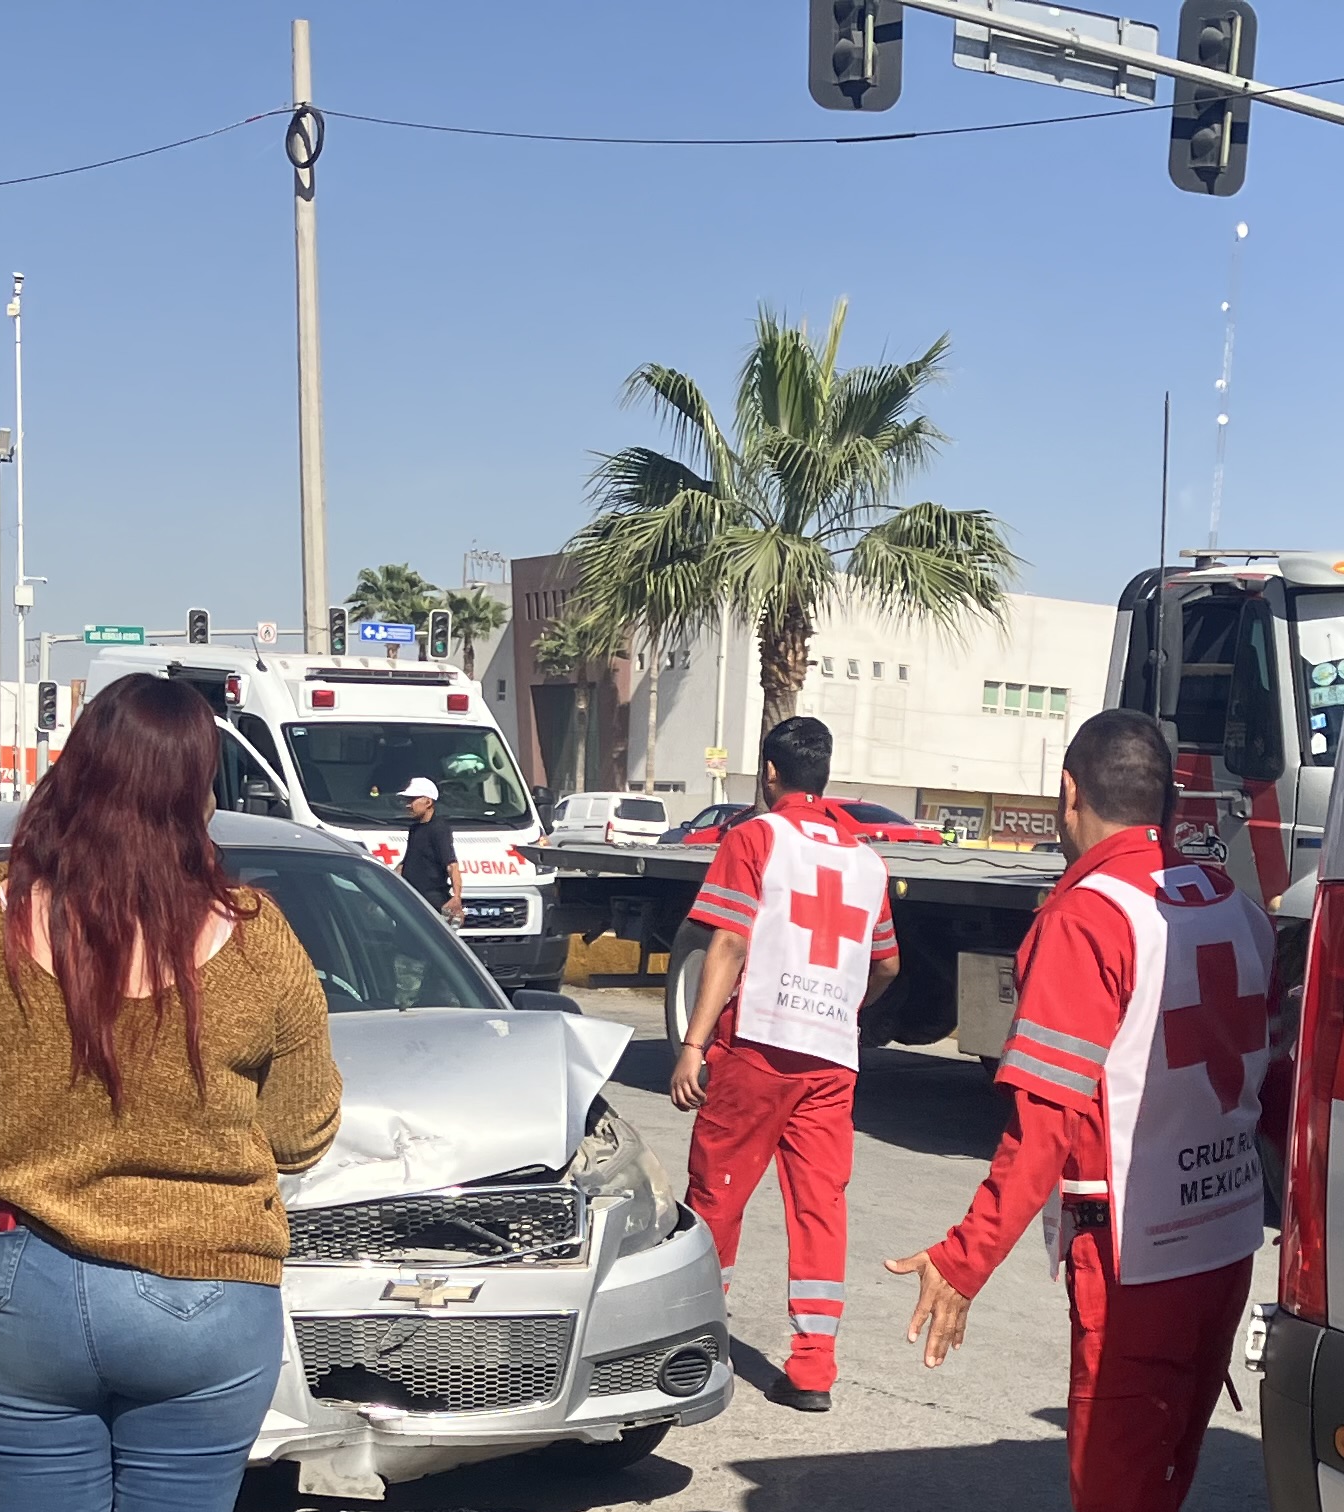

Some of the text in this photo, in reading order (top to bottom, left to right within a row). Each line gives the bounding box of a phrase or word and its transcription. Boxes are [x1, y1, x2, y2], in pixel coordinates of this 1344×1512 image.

[990, 810, 1057, 836] URREA
[780, 972, 819, 994] CRUZ
[1177, 1135, 1236, 1172] CRUZ
[1180, 1157, 1263, 1206] MEXICAN
